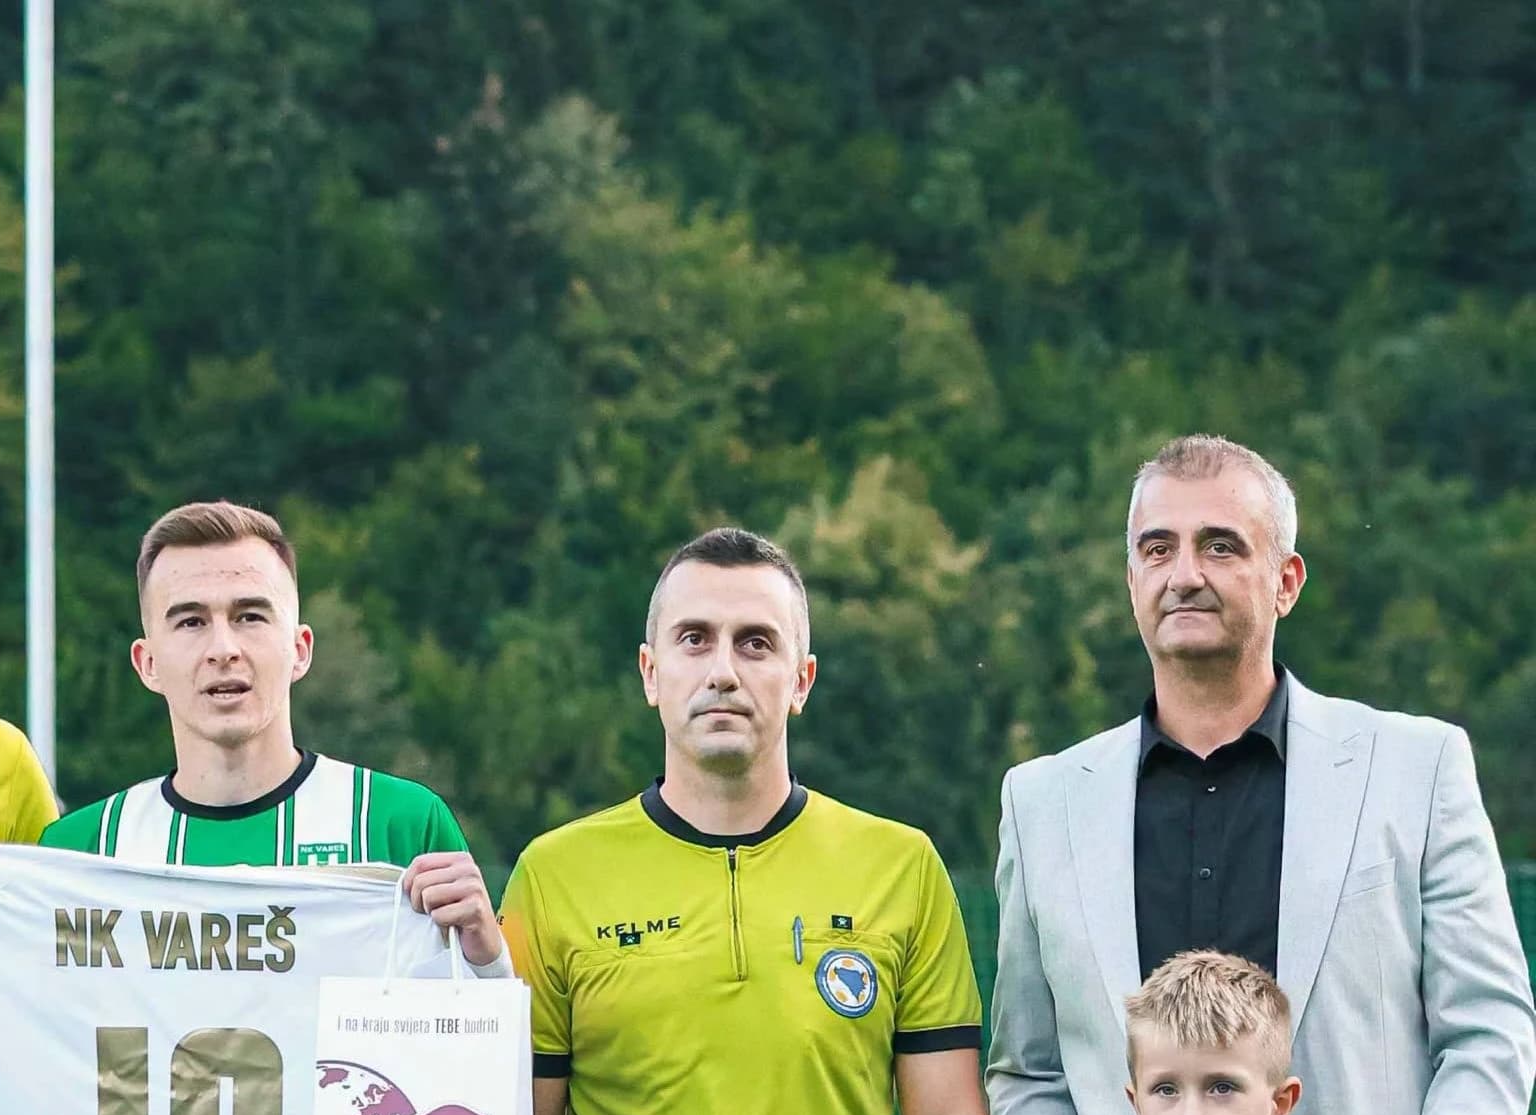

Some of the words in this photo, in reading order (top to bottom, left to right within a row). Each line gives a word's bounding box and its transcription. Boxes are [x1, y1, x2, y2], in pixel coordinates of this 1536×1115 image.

[54, 908, 124, 968] NK
[140, 905, 297, 973] VAREŠ
[596, 916, 681, 940] KELME
[345, 1016, 358, 1032] na
[362, 1015, 390, 1035] kraju
[393, 1017, 431, 1035] svijeta
[434, 1017, 461, 1034] TEBE
